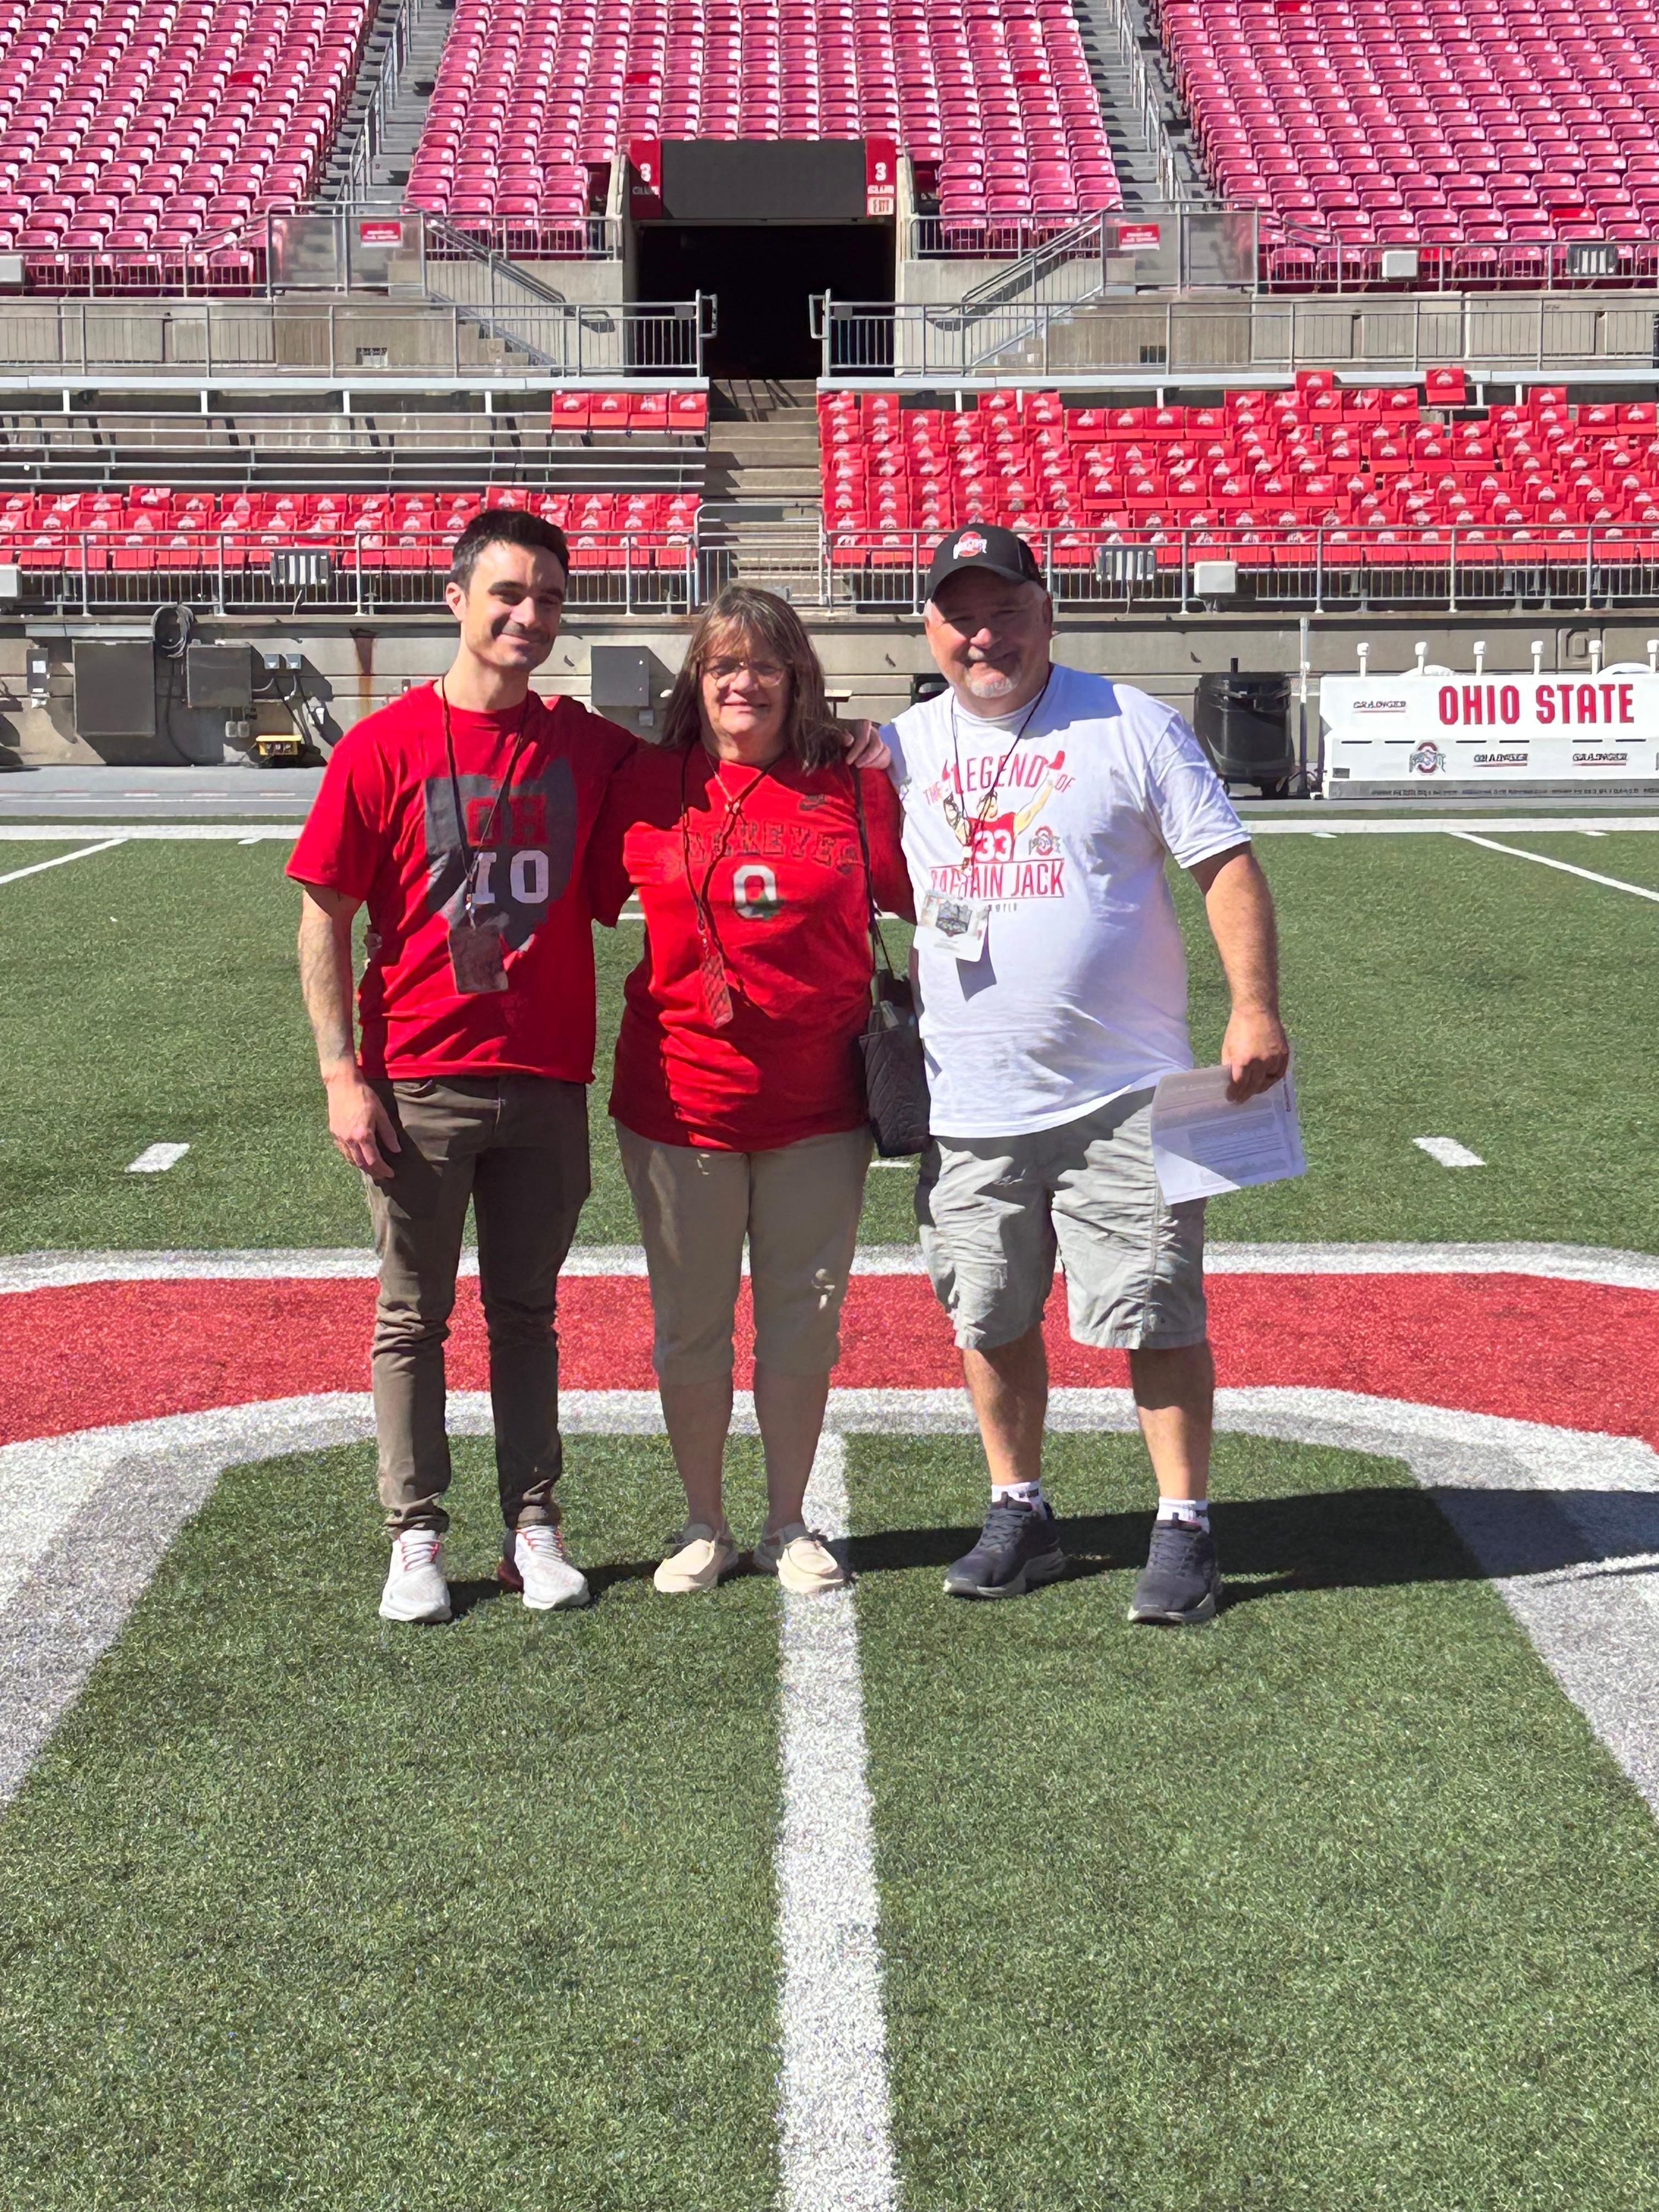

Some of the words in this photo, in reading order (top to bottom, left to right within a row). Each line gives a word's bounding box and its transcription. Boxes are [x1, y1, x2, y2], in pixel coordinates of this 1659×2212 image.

[1438, 685, 1520, 725] OHIO
[1536, 684, 1634, 724] STATE
[466, 794, 549, 847] OH
[974, 829, 1012, 861] 33
[1011, 860, 1065, 897] JACK
